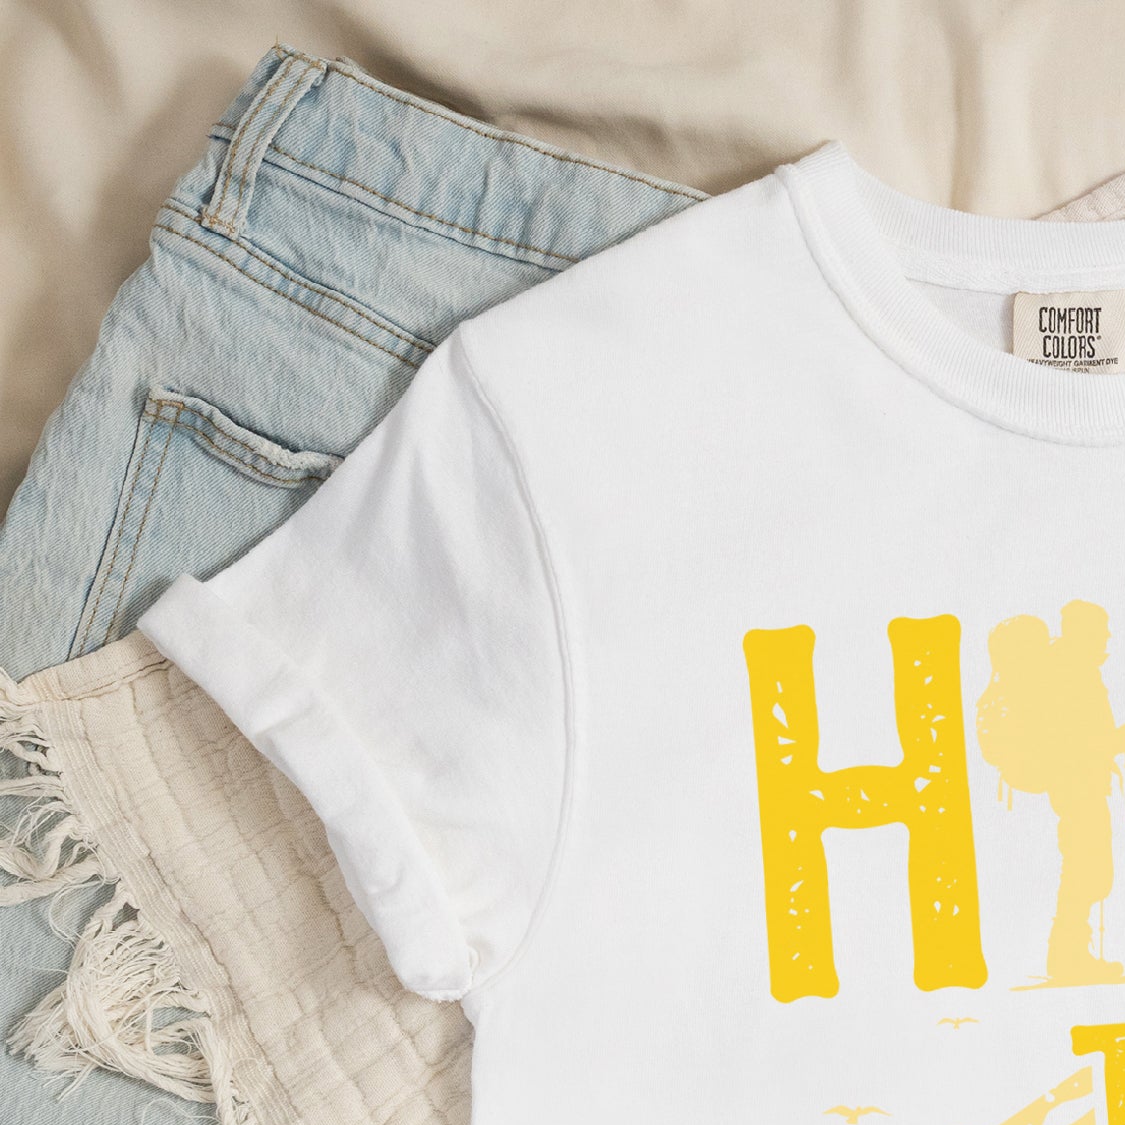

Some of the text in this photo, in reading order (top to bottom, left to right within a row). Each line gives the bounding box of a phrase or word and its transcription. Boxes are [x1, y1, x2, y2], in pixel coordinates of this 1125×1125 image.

[1038, 306, 1102, 334] COMFORT
[1042, 335, 1096, 359] COLORS
[1073, 358, 1105, 367] GARMENT
[1105, 357, 1119, 365] DYE
